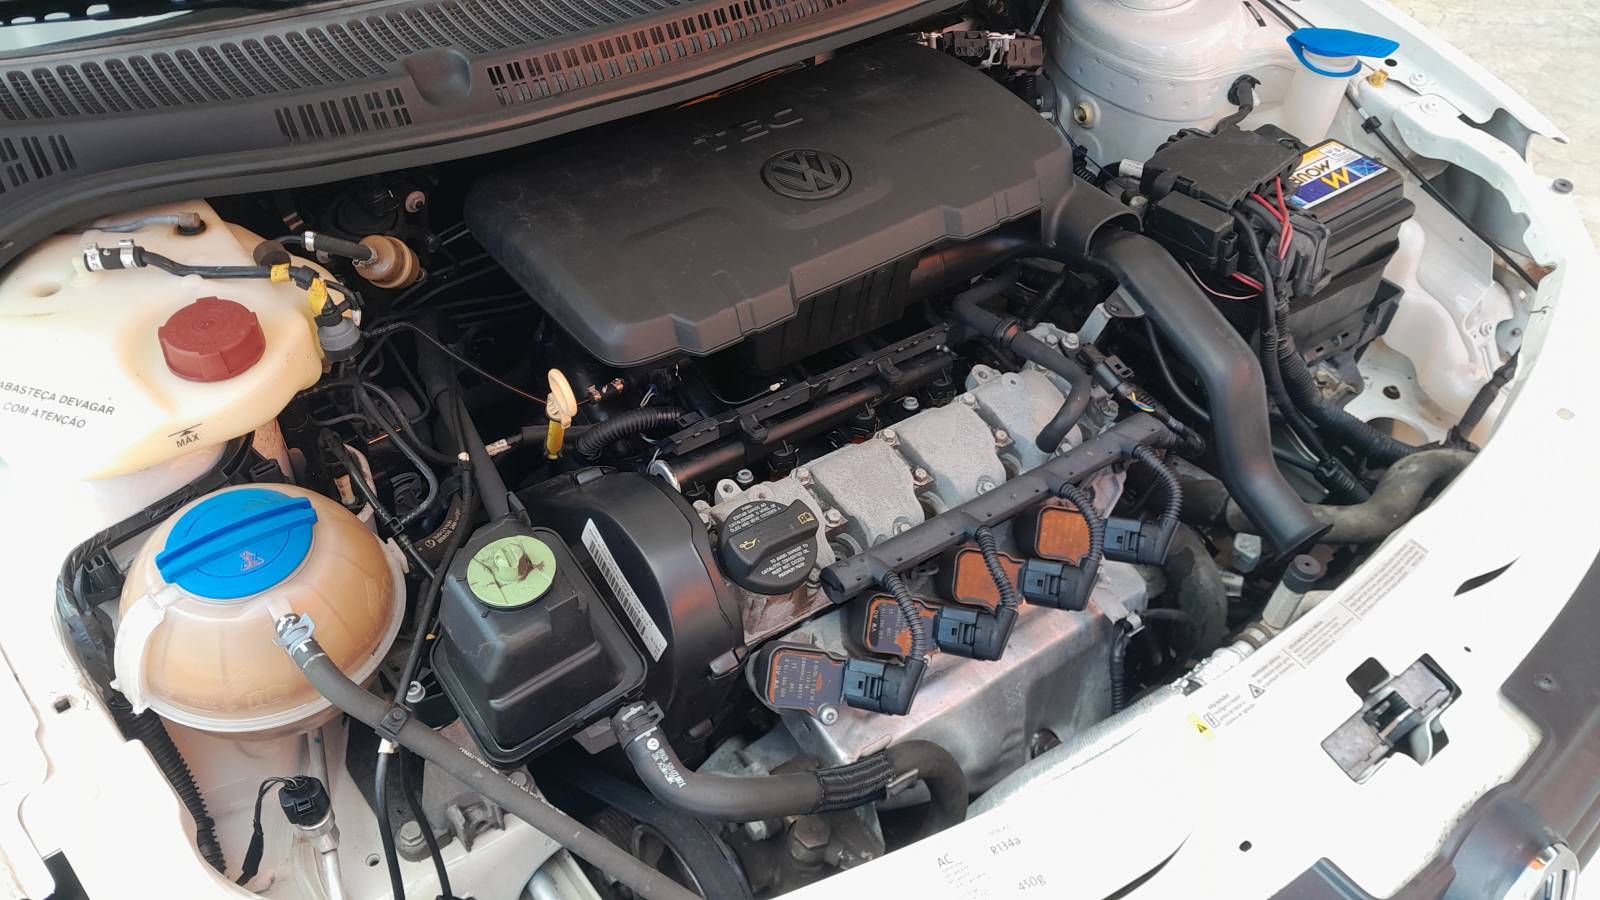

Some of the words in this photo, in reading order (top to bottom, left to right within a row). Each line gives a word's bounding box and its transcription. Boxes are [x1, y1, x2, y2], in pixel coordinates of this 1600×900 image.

[3, 402, 29, 414] COM
[59, 395, 115, 415] DEVAGAR
[990, 837, 1022, 856] R134a
[937, 853, 953, 868] AC
[1018, 874, 1047, 892] 450g
